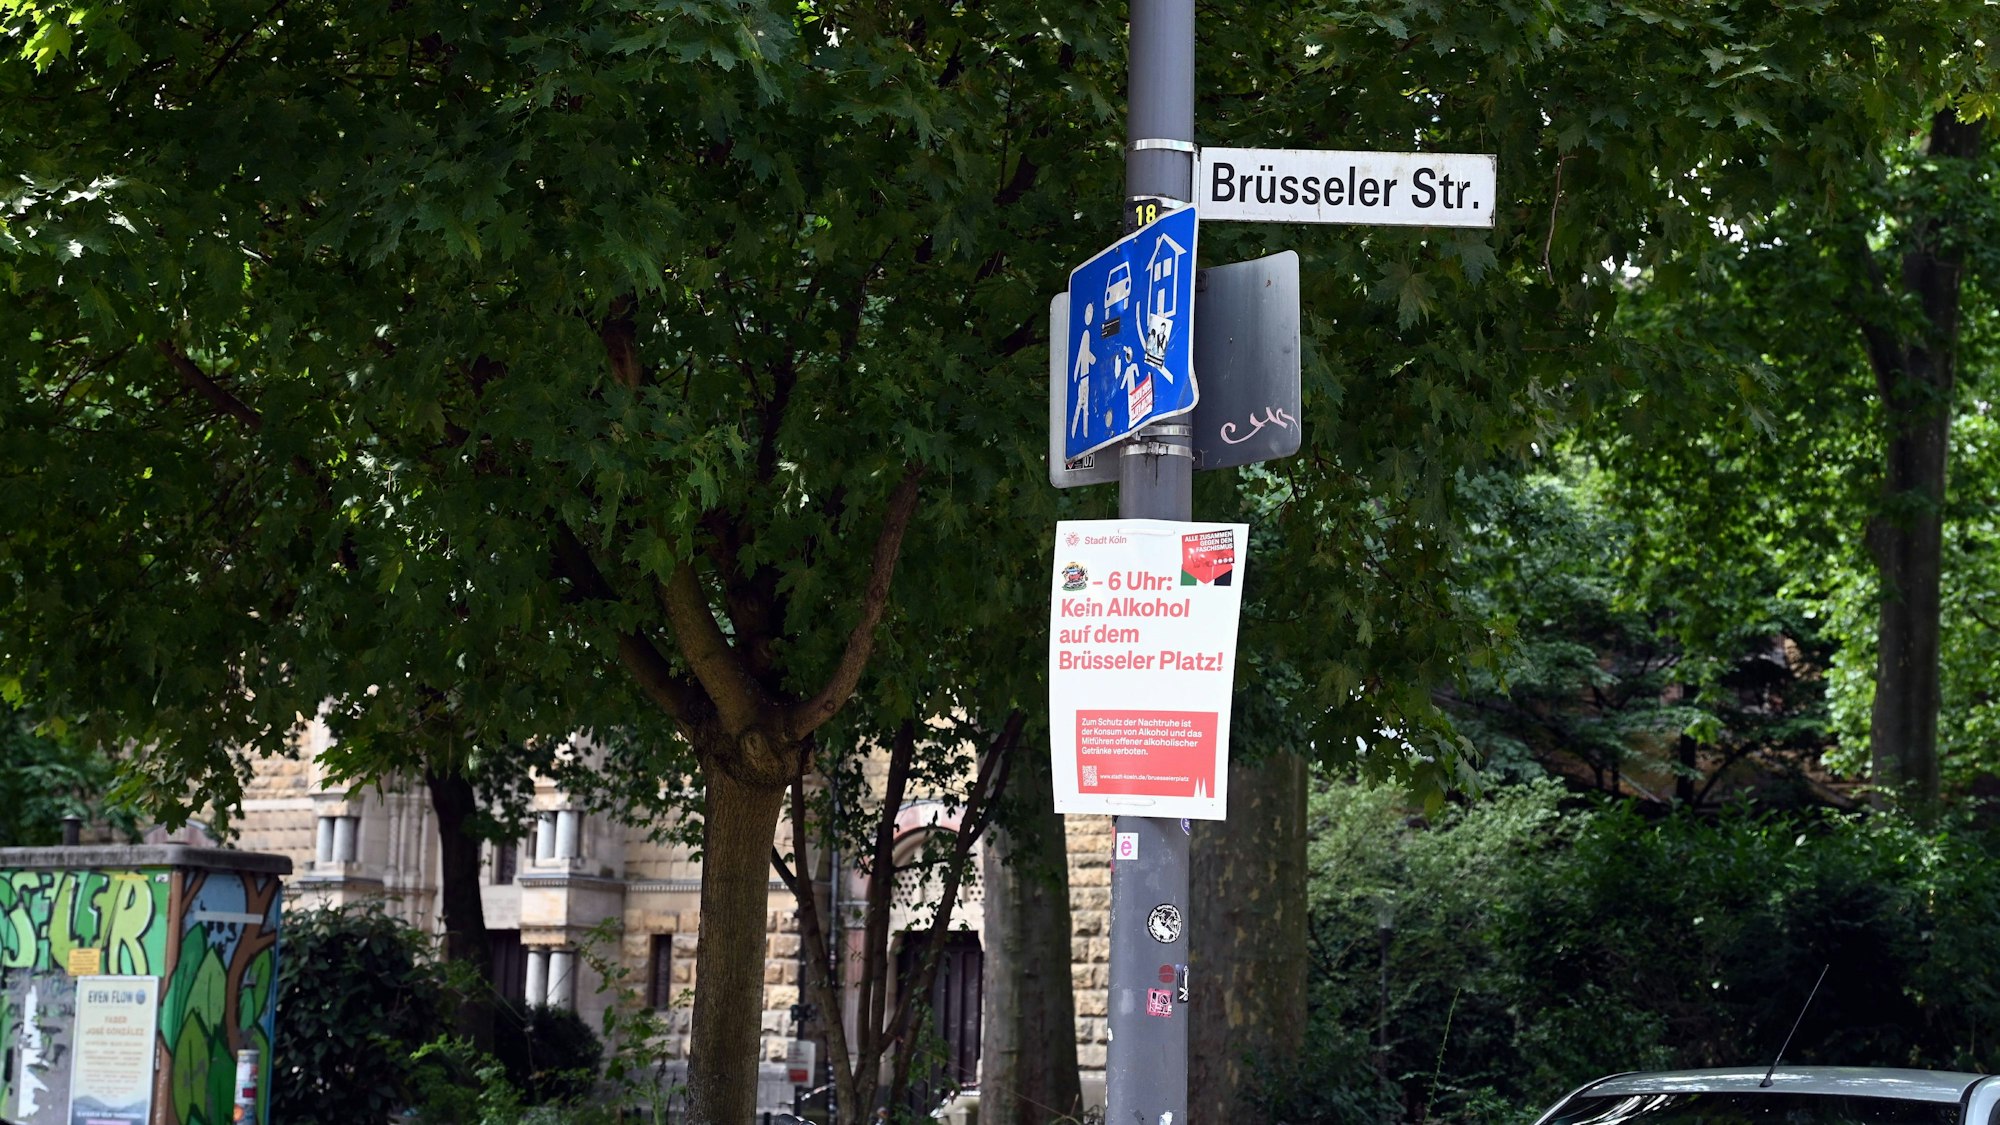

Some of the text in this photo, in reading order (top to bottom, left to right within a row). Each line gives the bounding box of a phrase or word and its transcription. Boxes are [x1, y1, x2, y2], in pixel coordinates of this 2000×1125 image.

[1211, 162, 1480, 209] Brüsseler Str.
[1135, 203, 1157, 226] 18
[1084, 535, 1127, 544] Stadt Köln
[1200, 531, 1233, 540] ZUSAMMEN
[1196, 543, 1233, 552] FASCHISMUS
[1108, 571, 1121, 591] 6
[1127, 571, 1172, 591] Uhr:
[1061, 597, 1190, 617] Kein Alkohol
[1059, 624, 1139, 643] auf dem
[1059, 650, 1223, 671] Brüsseler Platz!
[1082, 718, 1096, 726] Zum
[1098, 718, 1122, 726] Schutz
[1124, 718, 1136, 726] der
[1138, 718, 1179, 728] Nachtruhe
[1094, 728, 1122, 736] Konsum
[1138, 728, 1168, 737] Alkohol
[1170, 729, 1185, 737] und
[1188, 730, 1202, 738] das
[1082, 737, 1198, 747] Mitführen offener alkoholischer
[1082, 747, 1148, 756] Getränke verboten.
[1121, 836, 1132, 857] ë
[88, 990, 133, 1003] EVEN FLOW
